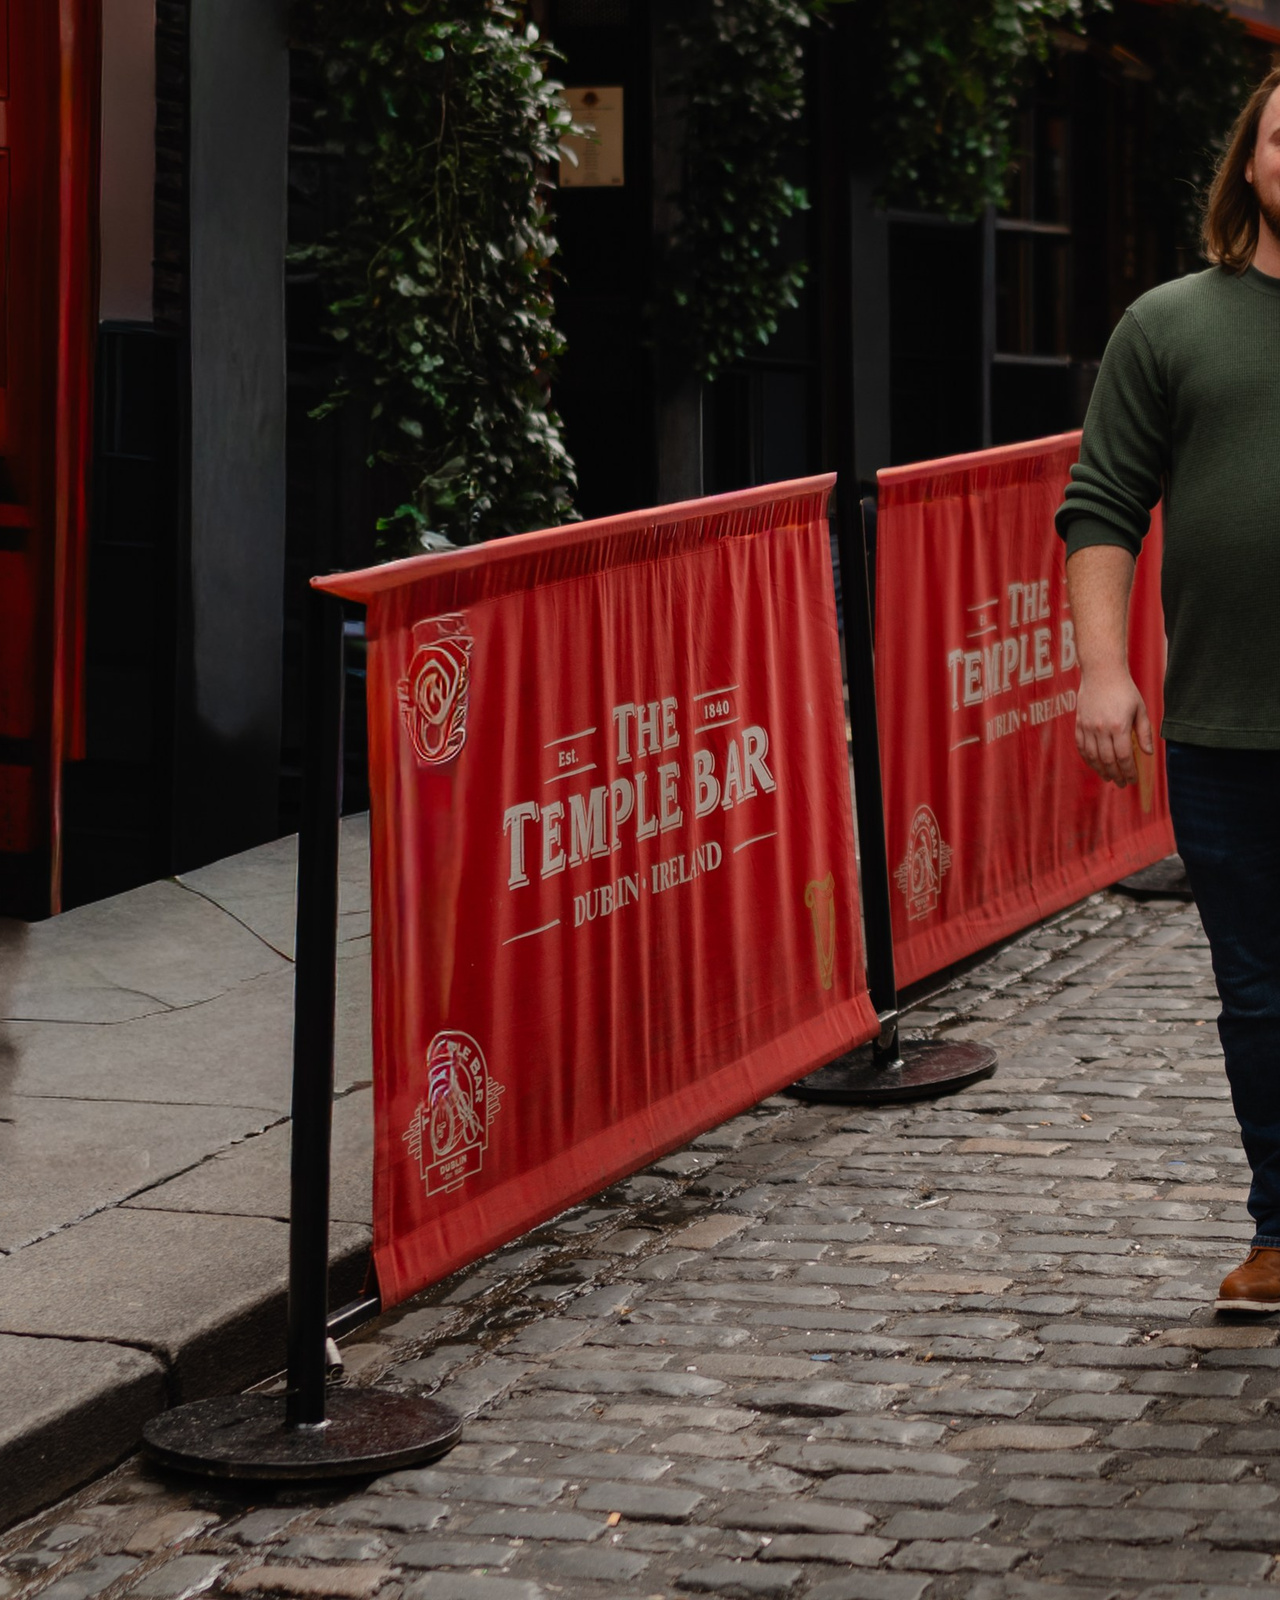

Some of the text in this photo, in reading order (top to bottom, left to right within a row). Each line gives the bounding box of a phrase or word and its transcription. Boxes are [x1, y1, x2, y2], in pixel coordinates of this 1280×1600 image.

[1008, 580, 1050, 628] THE
[948, 628, 1054, 712] TEMPLE
[558, 697, 730, 768] Est. THE 1840
[986, 690, 1077, 745] DUBLIN IRELAND
[503, 725, 777, 891] TEMPLE BAR
[573, 841, 723, 928] DUBLIN IRELAND
[469, 1056, 485, 1103] BAR
[439, 1154, 468, 1176] DUBLIN
